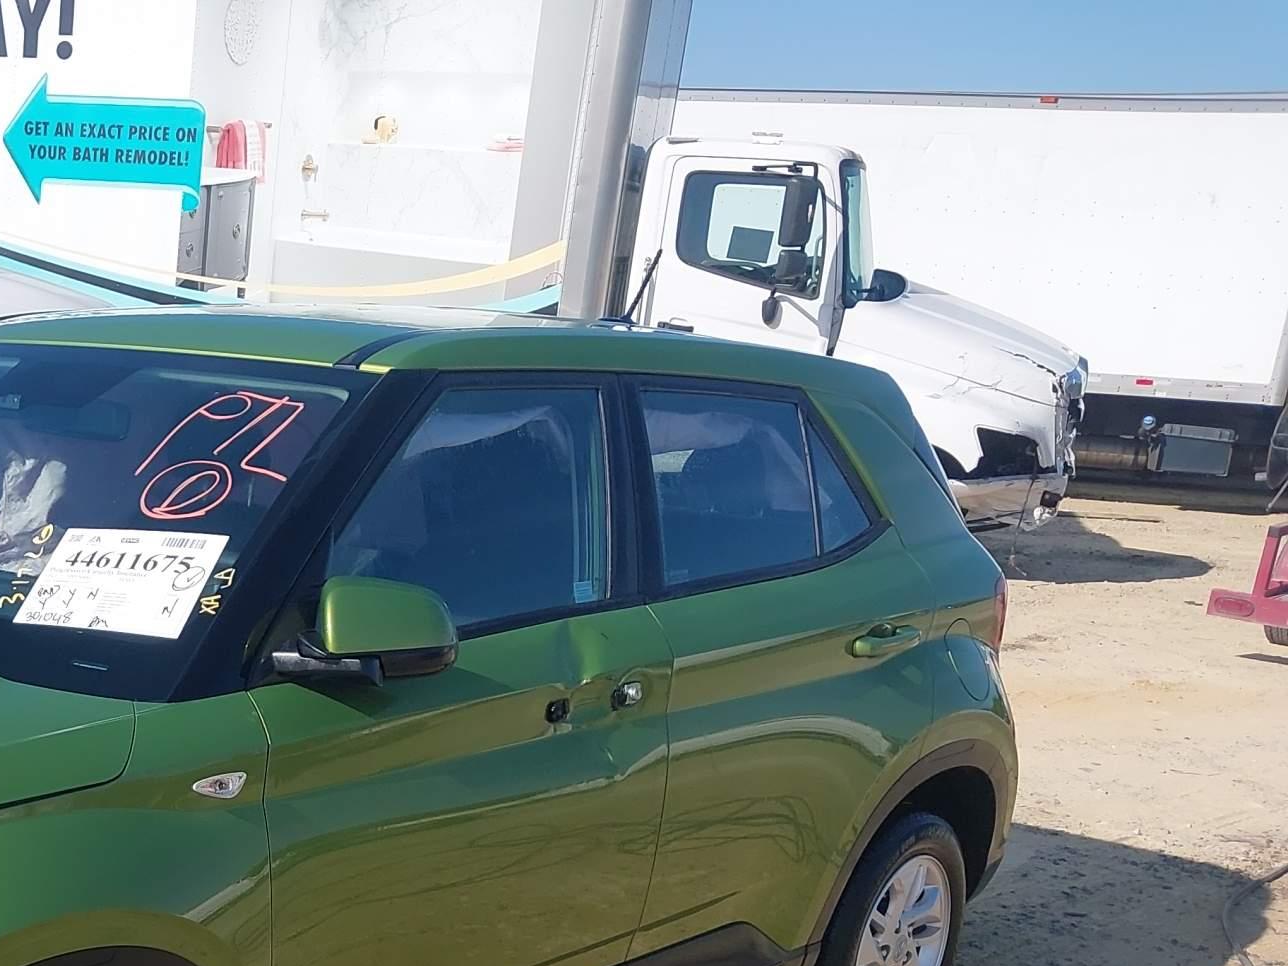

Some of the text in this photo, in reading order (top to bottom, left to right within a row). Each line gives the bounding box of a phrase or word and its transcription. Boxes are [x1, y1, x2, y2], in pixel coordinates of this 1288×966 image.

[24, 120, 197, 143] GET AN EXACT PRICE ON
[29, 143, 189, 167] YOUR BATH REMODEL!
[65, 549, 195, 574] 44611675
